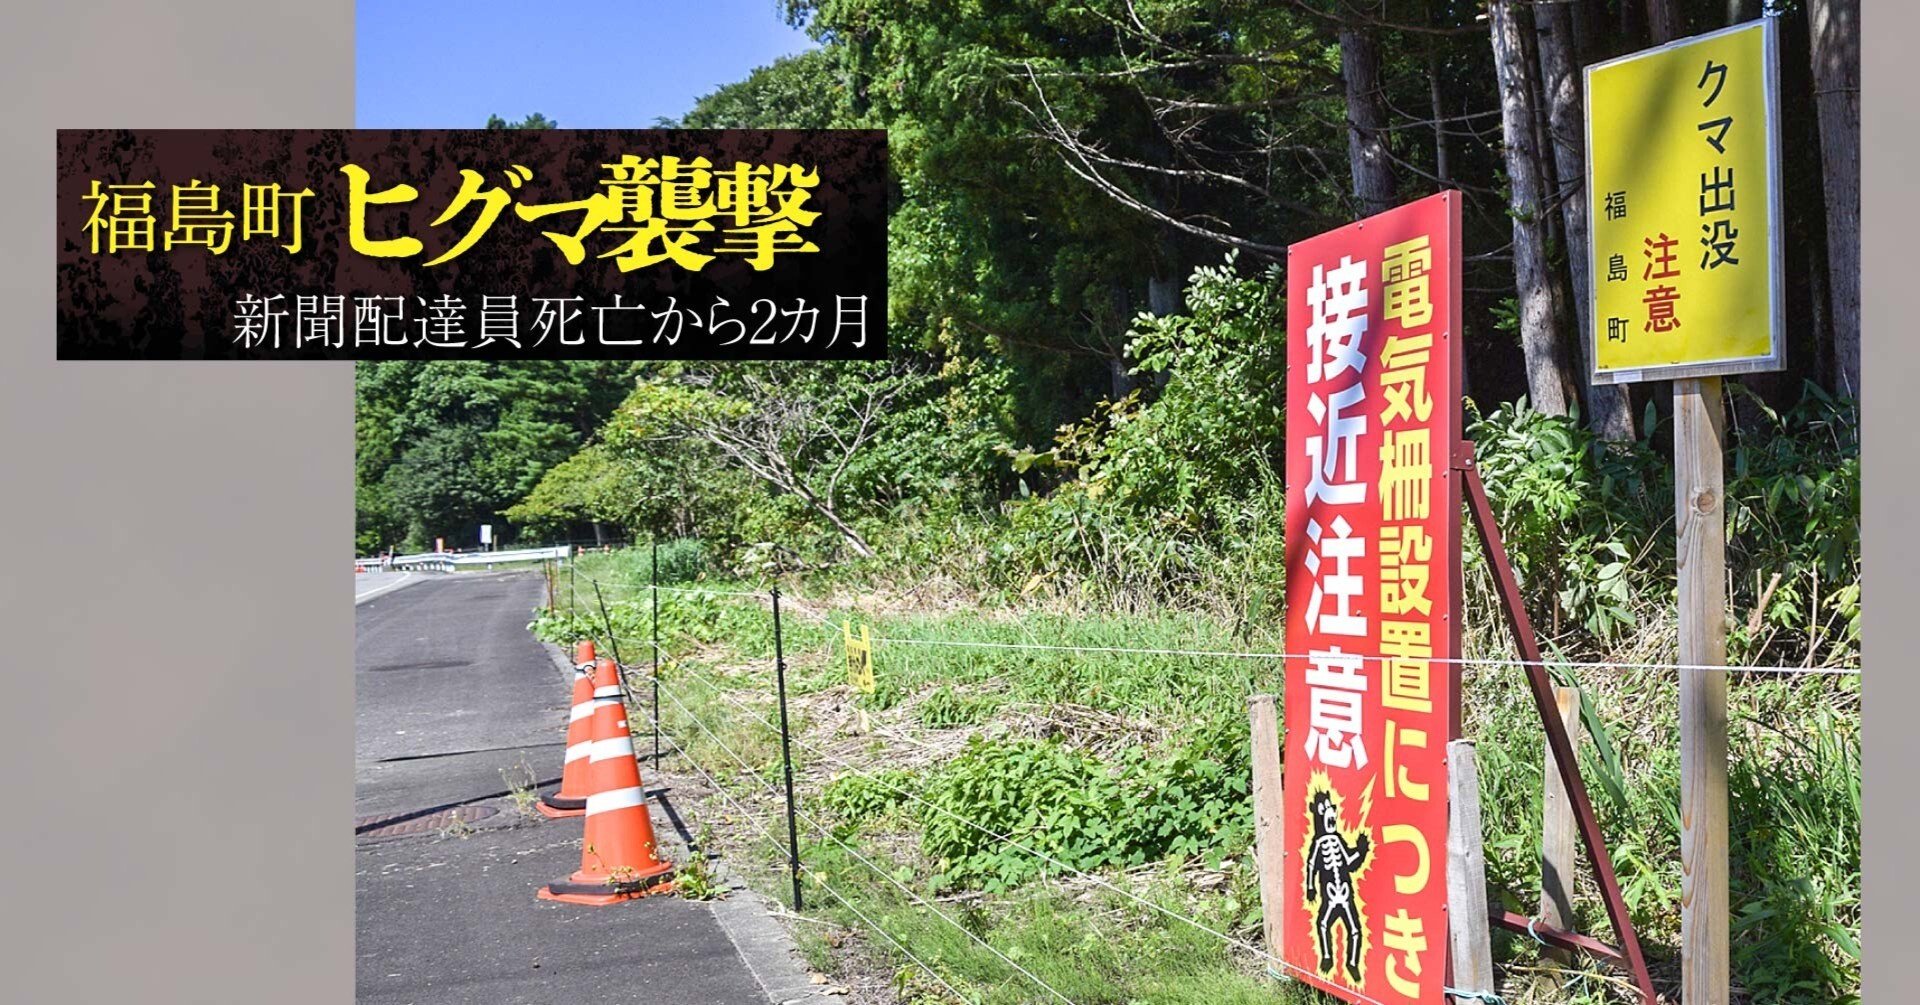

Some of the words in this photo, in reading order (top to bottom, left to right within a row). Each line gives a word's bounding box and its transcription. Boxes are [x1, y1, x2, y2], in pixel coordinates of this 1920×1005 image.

[1604, 190, 1630, 343] 福島町
[1697, 60, 1740, 271] クマ出没
[1642, 233, 1681, 334] 注意
[1304, 255, 1368, 771] 接近注意
[1378, 235, 1433, 999] 電気柵設置につき
